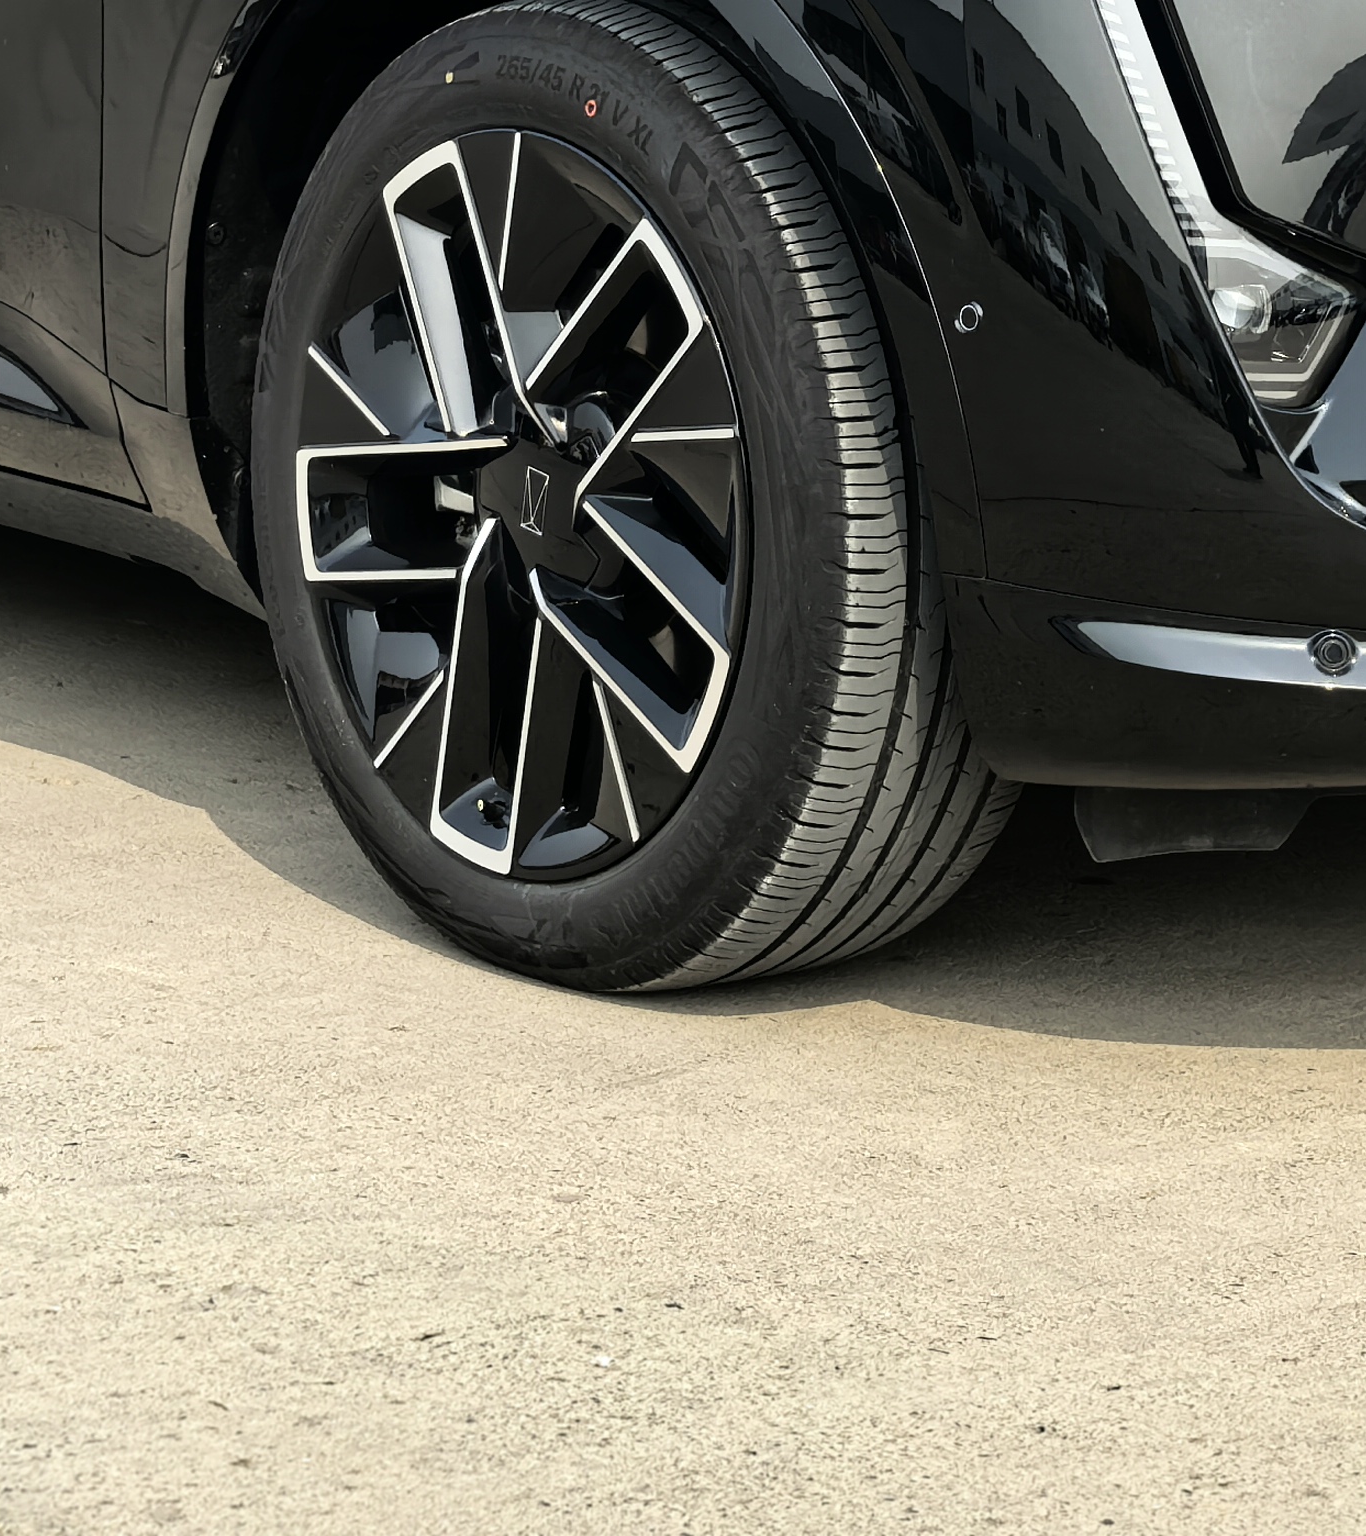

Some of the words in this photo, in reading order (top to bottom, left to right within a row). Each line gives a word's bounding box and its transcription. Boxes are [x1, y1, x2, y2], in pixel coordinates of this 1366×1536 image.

[495, 54, 566, 92] 265/45
[568, 72, 585, 103] R
[612, 99, 630, 127] V
[628, 115, 654, 157] XL
